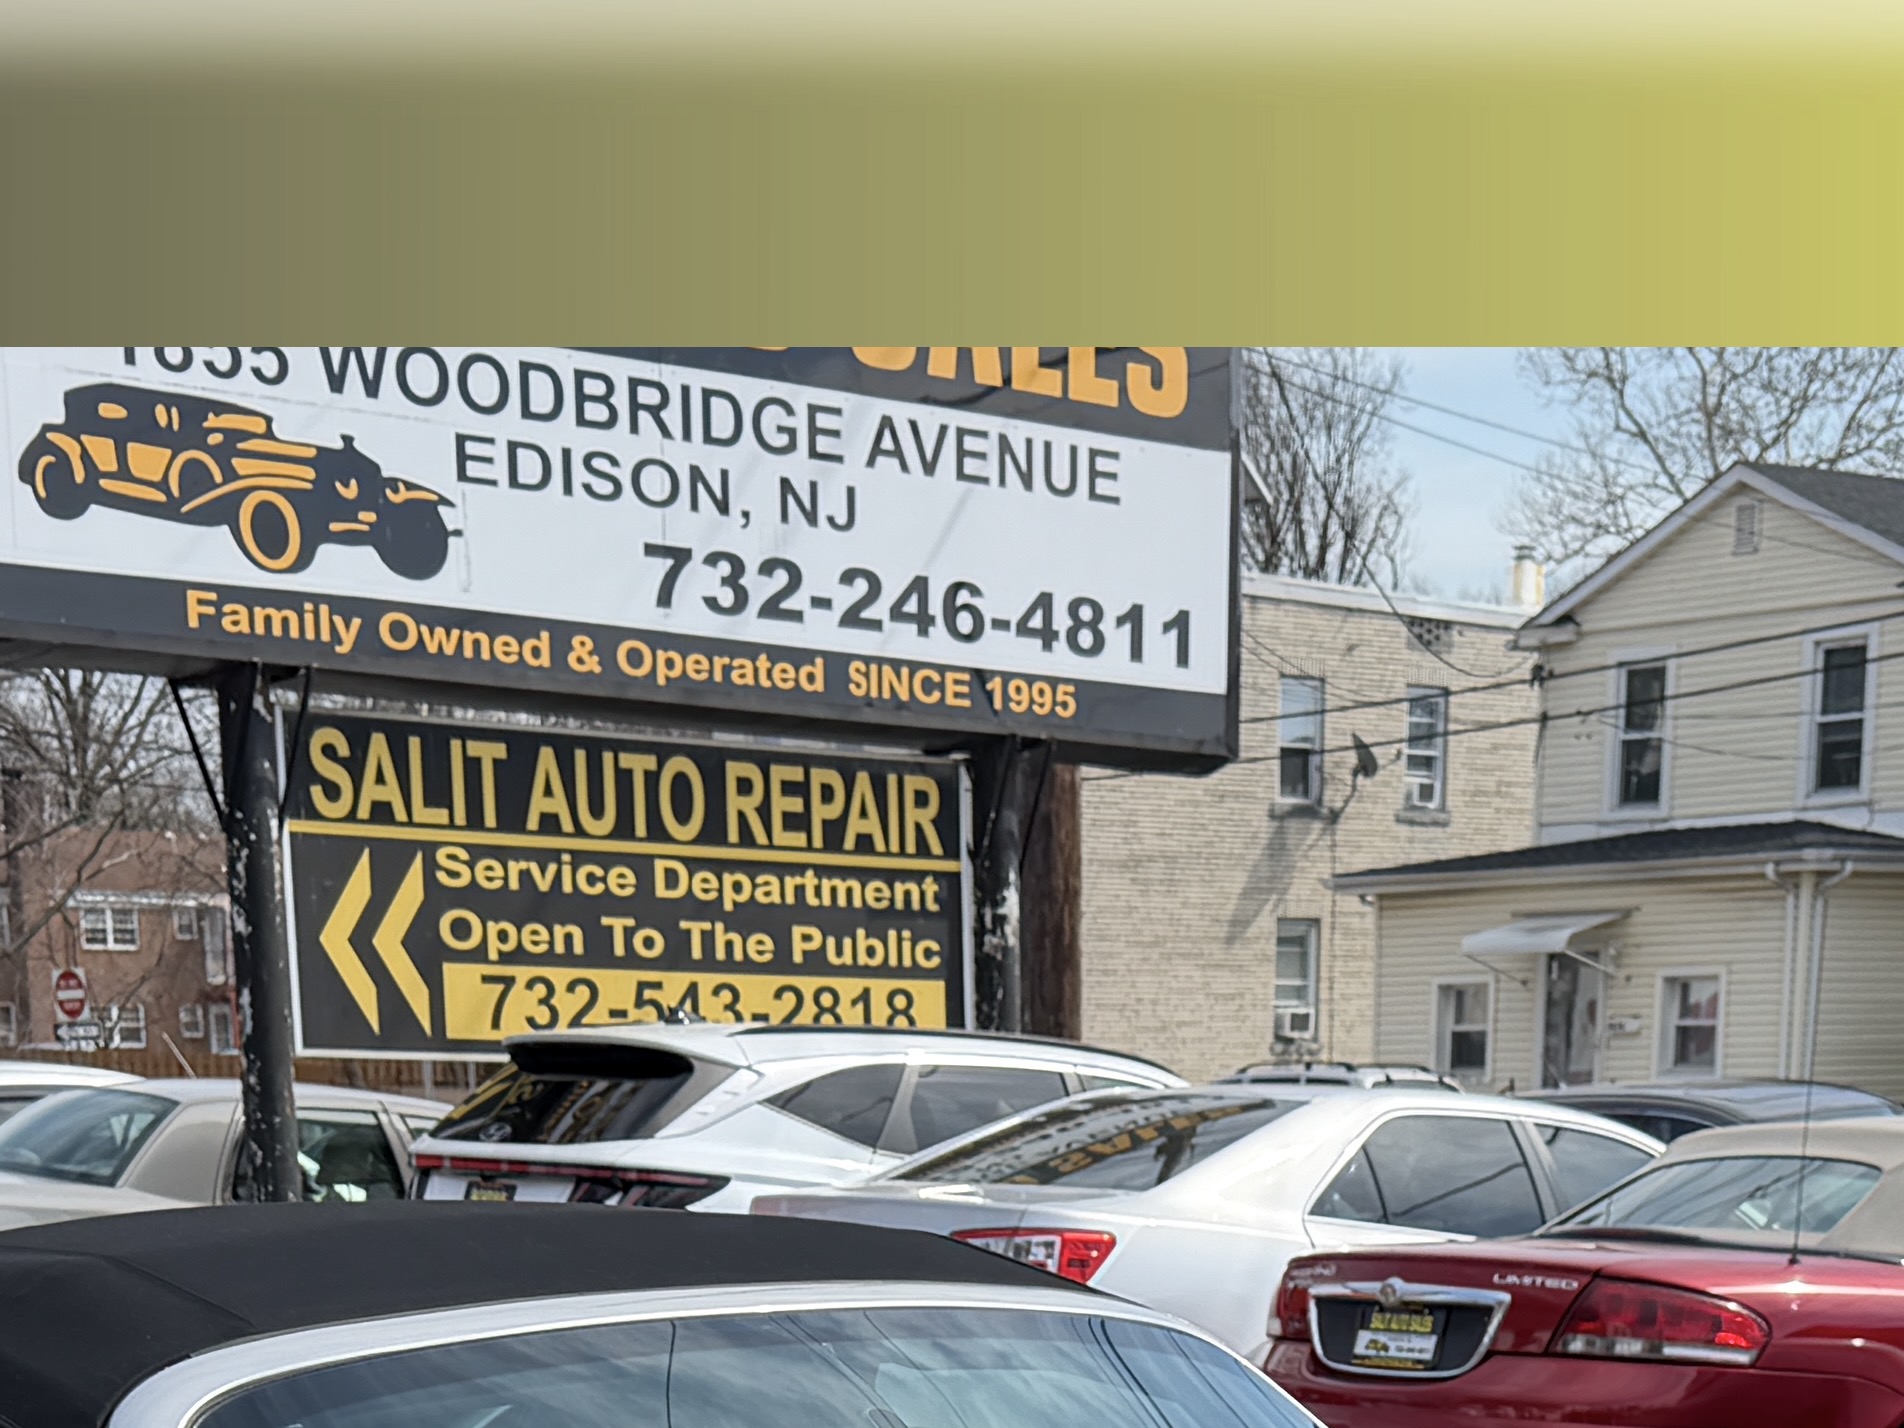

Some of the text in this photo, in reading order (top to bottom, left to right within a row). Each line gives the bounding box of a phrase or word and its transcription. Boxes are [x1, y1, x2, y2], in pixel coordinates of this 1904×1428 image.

[318, 347, 846, 464] WOODBRIDGE
[866, 414, 1122, 505] AVENUE
[456, 432, 856, 533] EDISON, NJ
[185, 588, 1078, 719] Family Owned & Operated SINCE 1995
[642, 541, 1192, 669] 732-246-4811
[307, 726, 945, 856] SALIT AUTO REPAIR
[434, 845, 940, 913] Service Department
[438, 907, 942, 970] Open To The Public
[480, 973, 917, 1032] 732-543-2818
